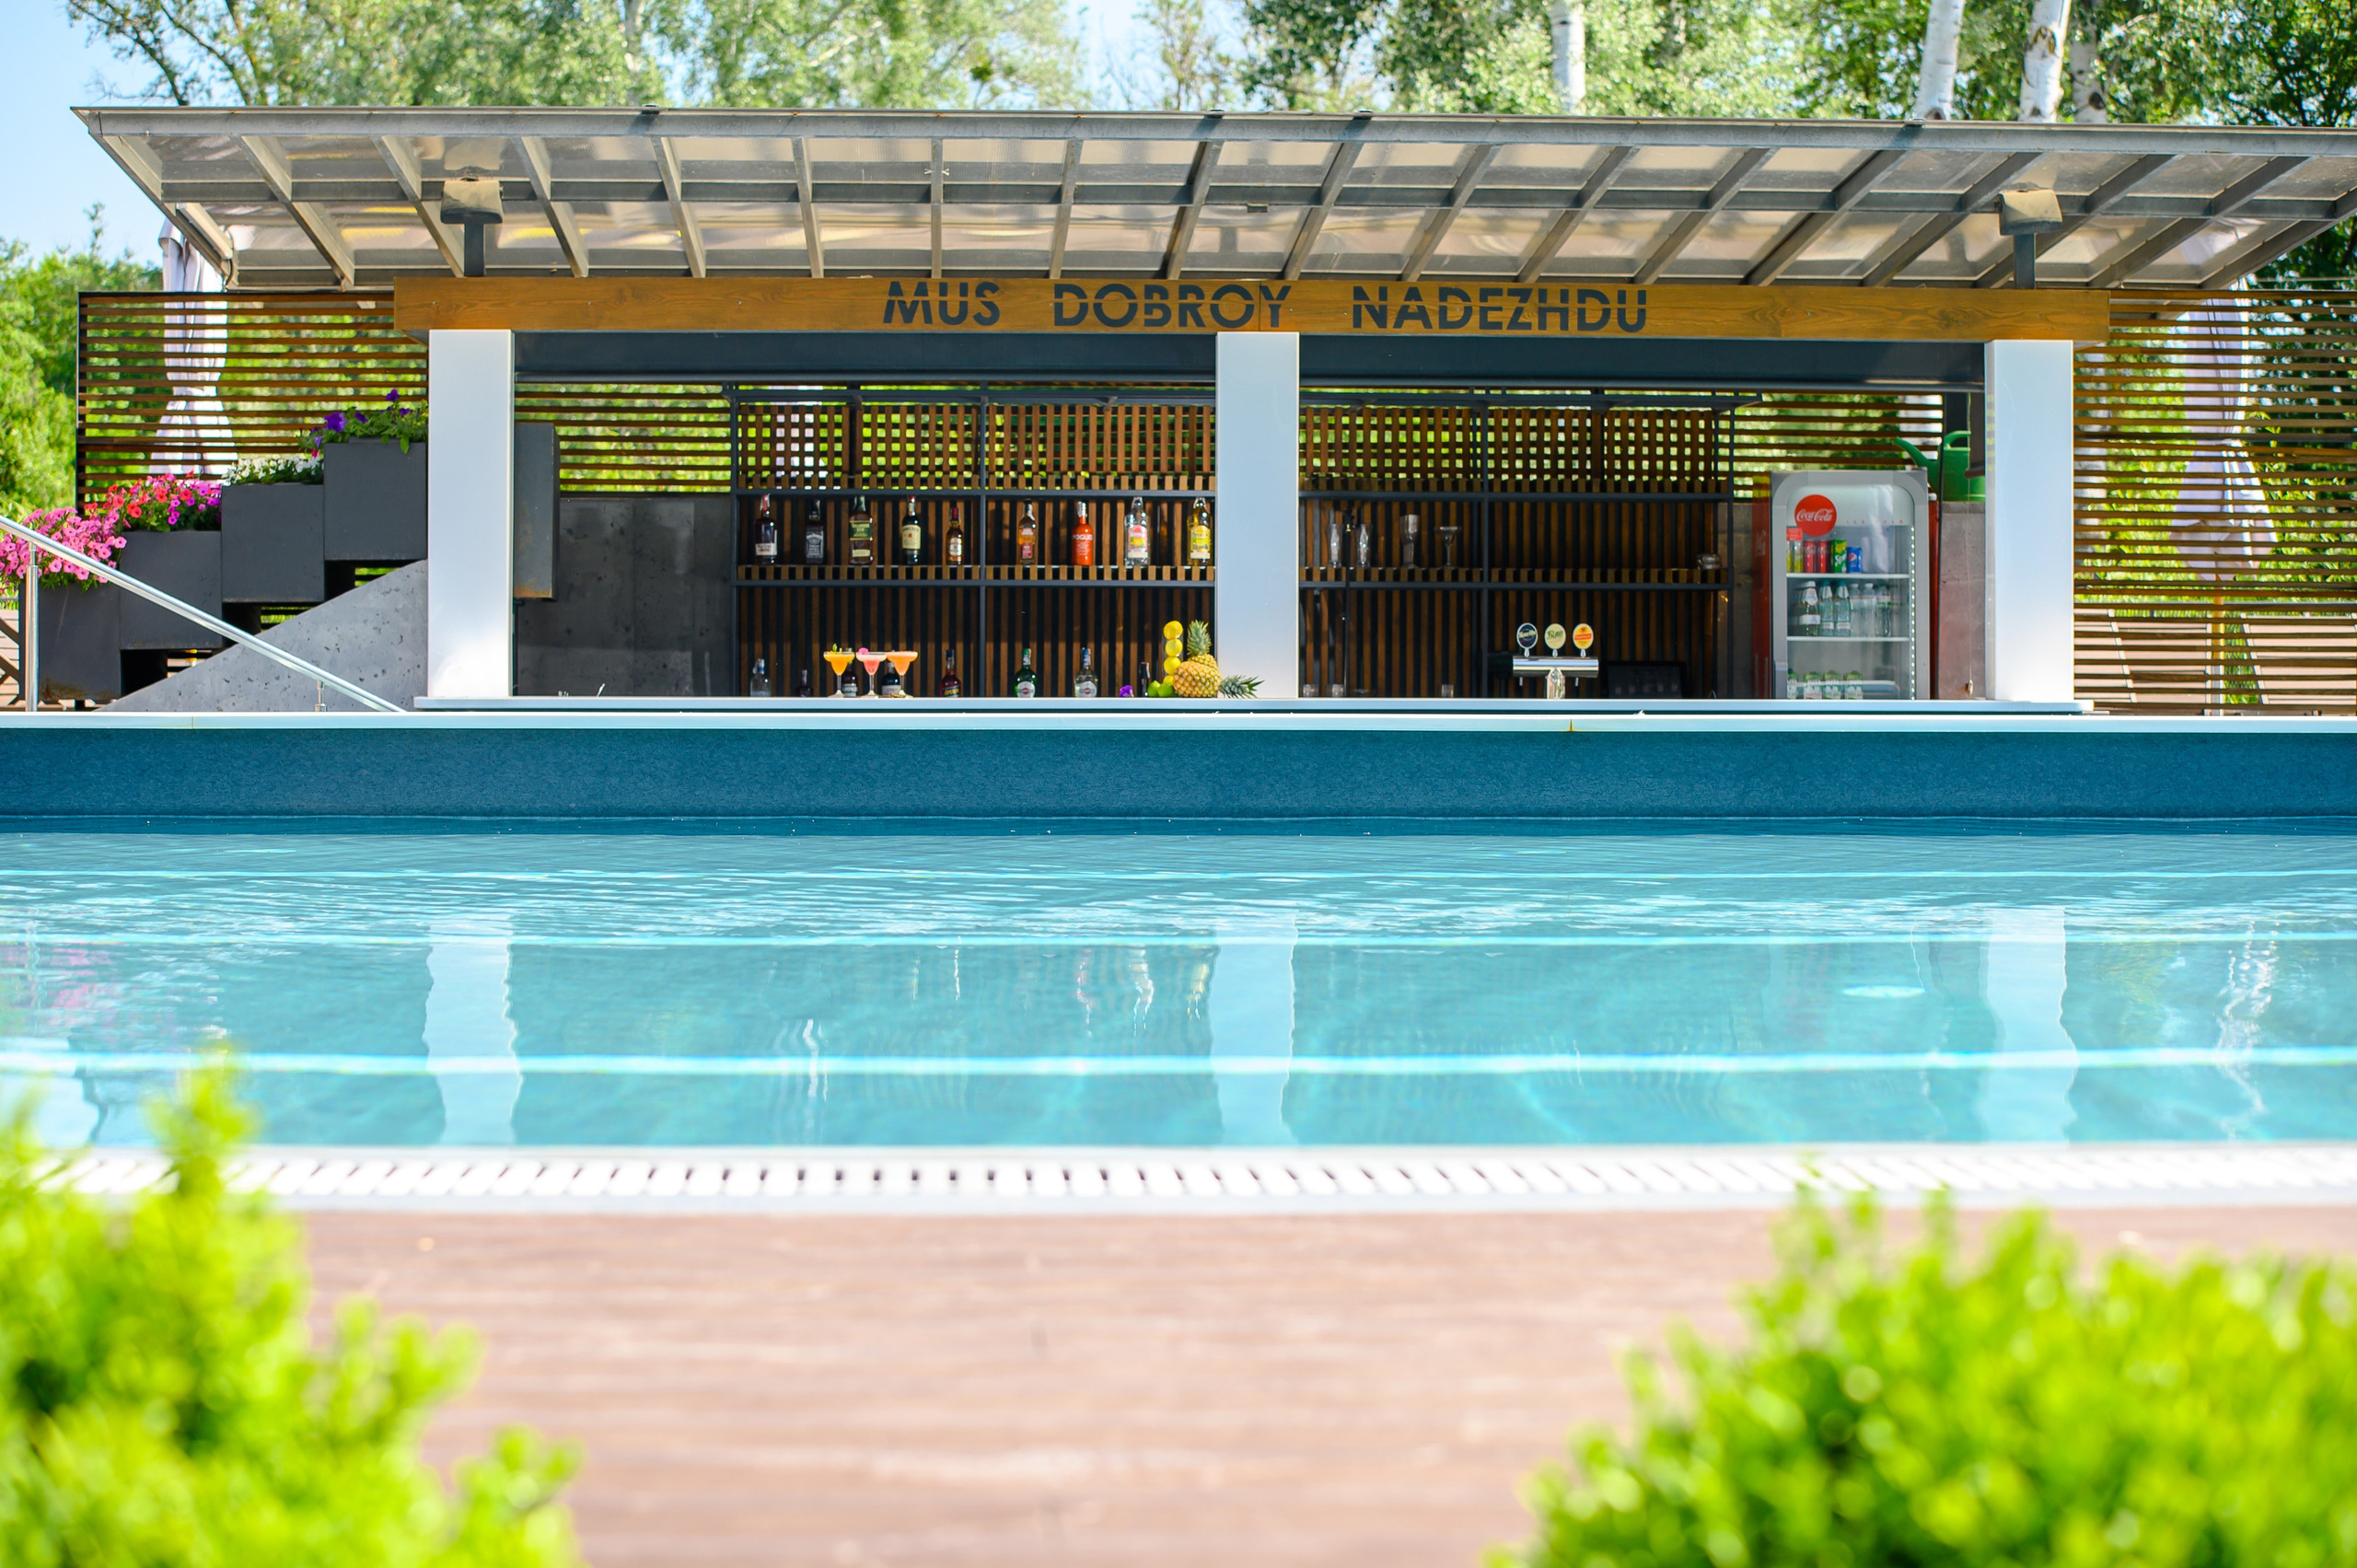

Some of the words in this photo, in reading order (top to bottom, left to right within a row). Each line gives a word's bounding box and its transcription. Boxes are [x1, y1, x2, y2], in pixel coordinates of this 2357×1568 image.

[883, 281, 1000, 325] MUS
[1054, 284, 1292, 328] DOBROY
[1353, 285, 1647, 333] NADEZHDU
